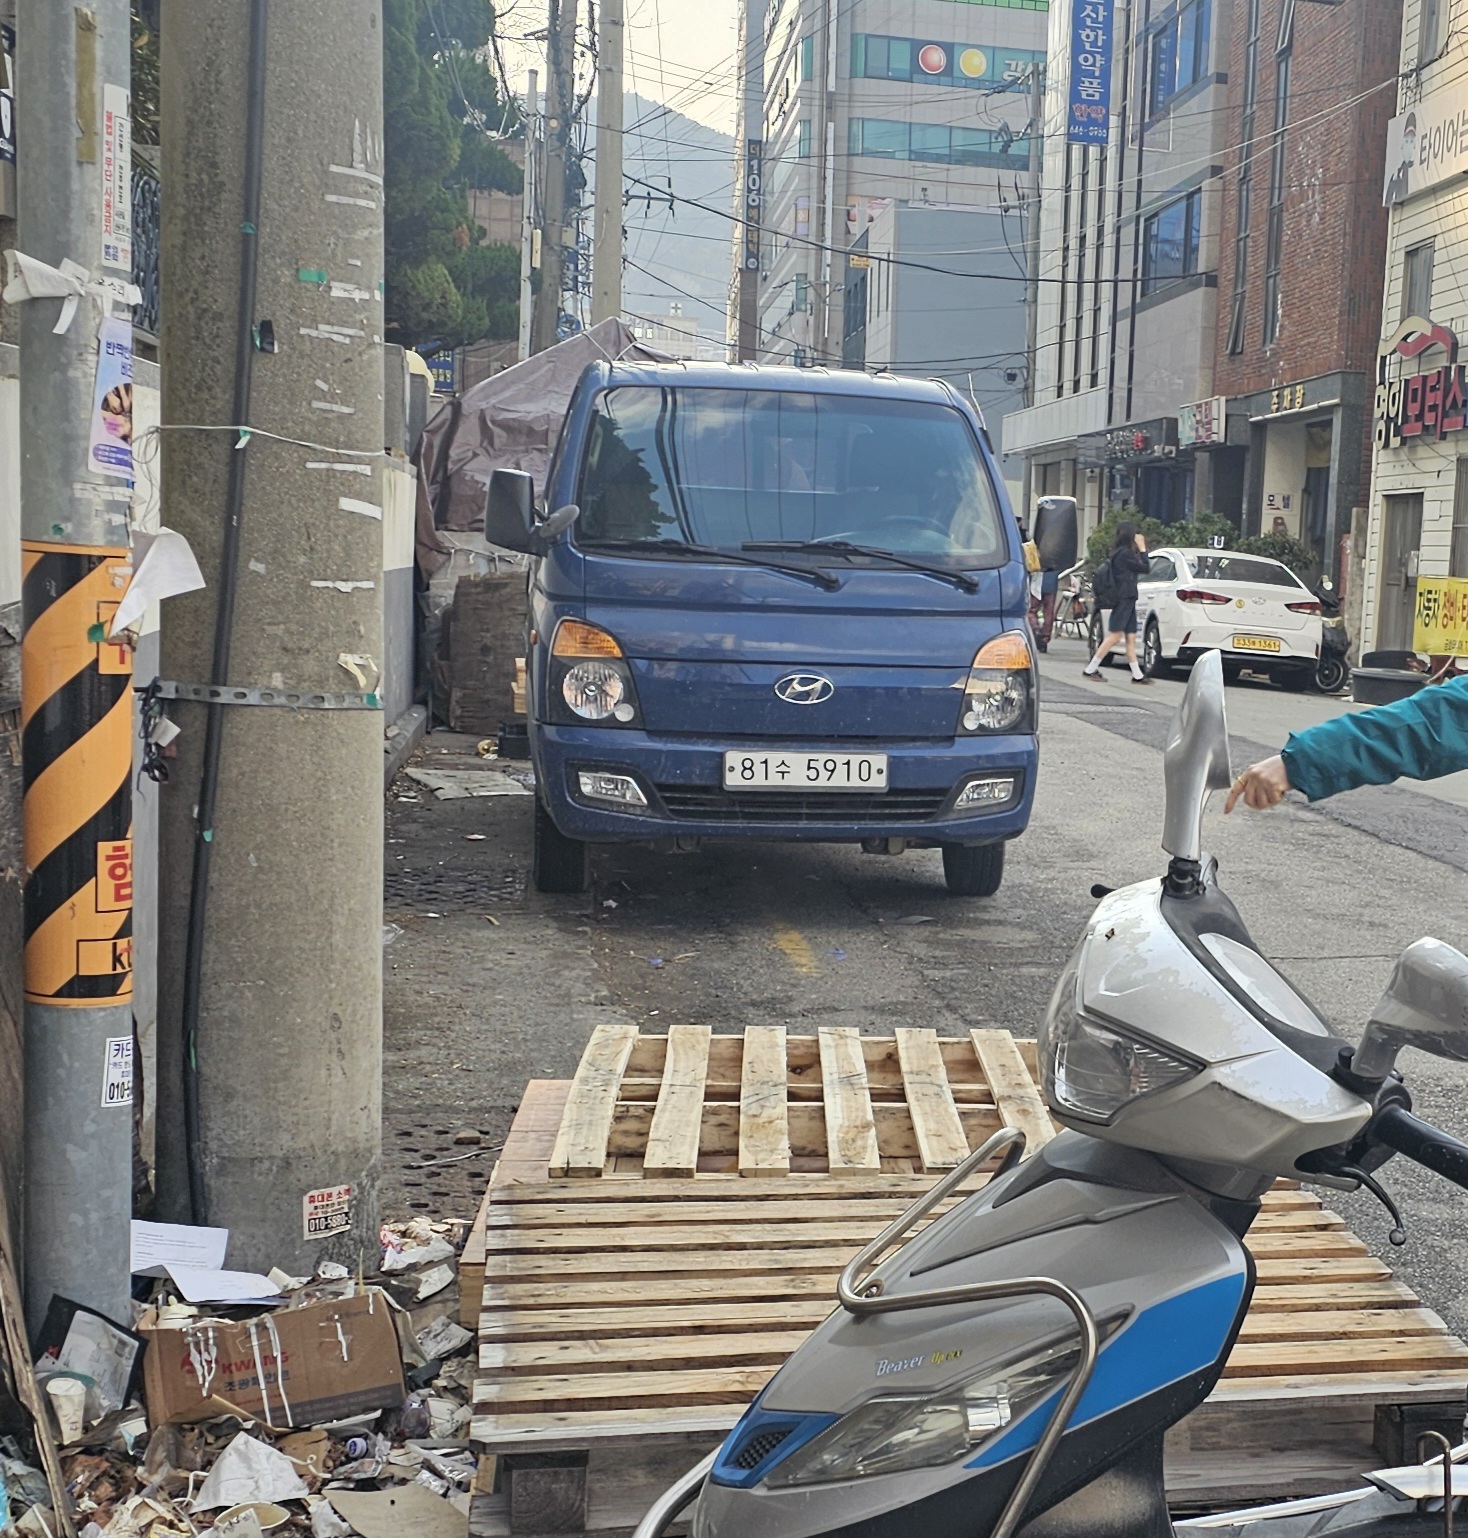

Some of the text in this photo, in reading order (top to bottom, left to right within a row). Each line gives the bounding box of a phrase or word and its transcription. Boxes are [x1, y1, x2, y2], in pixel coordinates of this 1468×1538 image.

[1077, 0, 1108, 101] 산한약품
[1270, 384, 1306, 413] 주차장
[1416, 588, 1441, 629] 자동차
[740, 757, 872, 782] 81수 5910
[876, 1354, 926, 1377] Beaver
